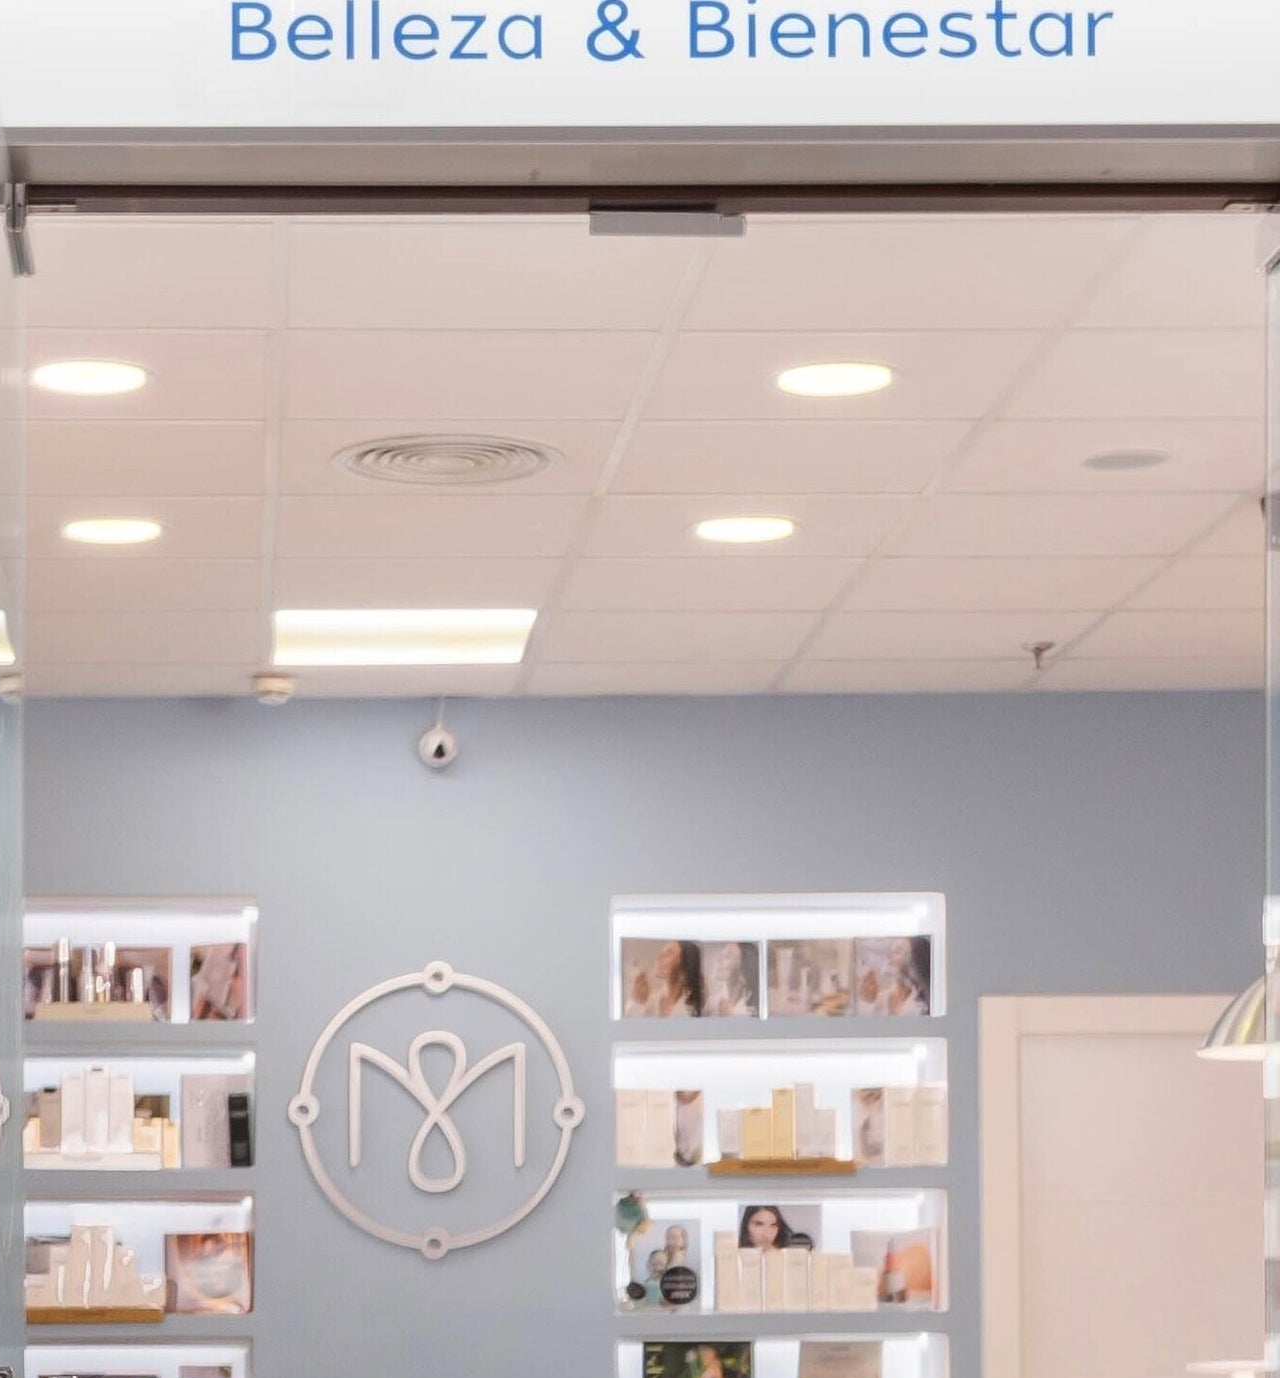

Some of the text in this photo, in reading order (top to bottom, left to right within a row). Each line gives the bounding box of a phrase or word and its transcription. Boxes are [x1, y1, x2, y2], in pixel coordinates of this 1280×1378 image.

[231, 0, 1114, 62] Belleza & Bienestar
